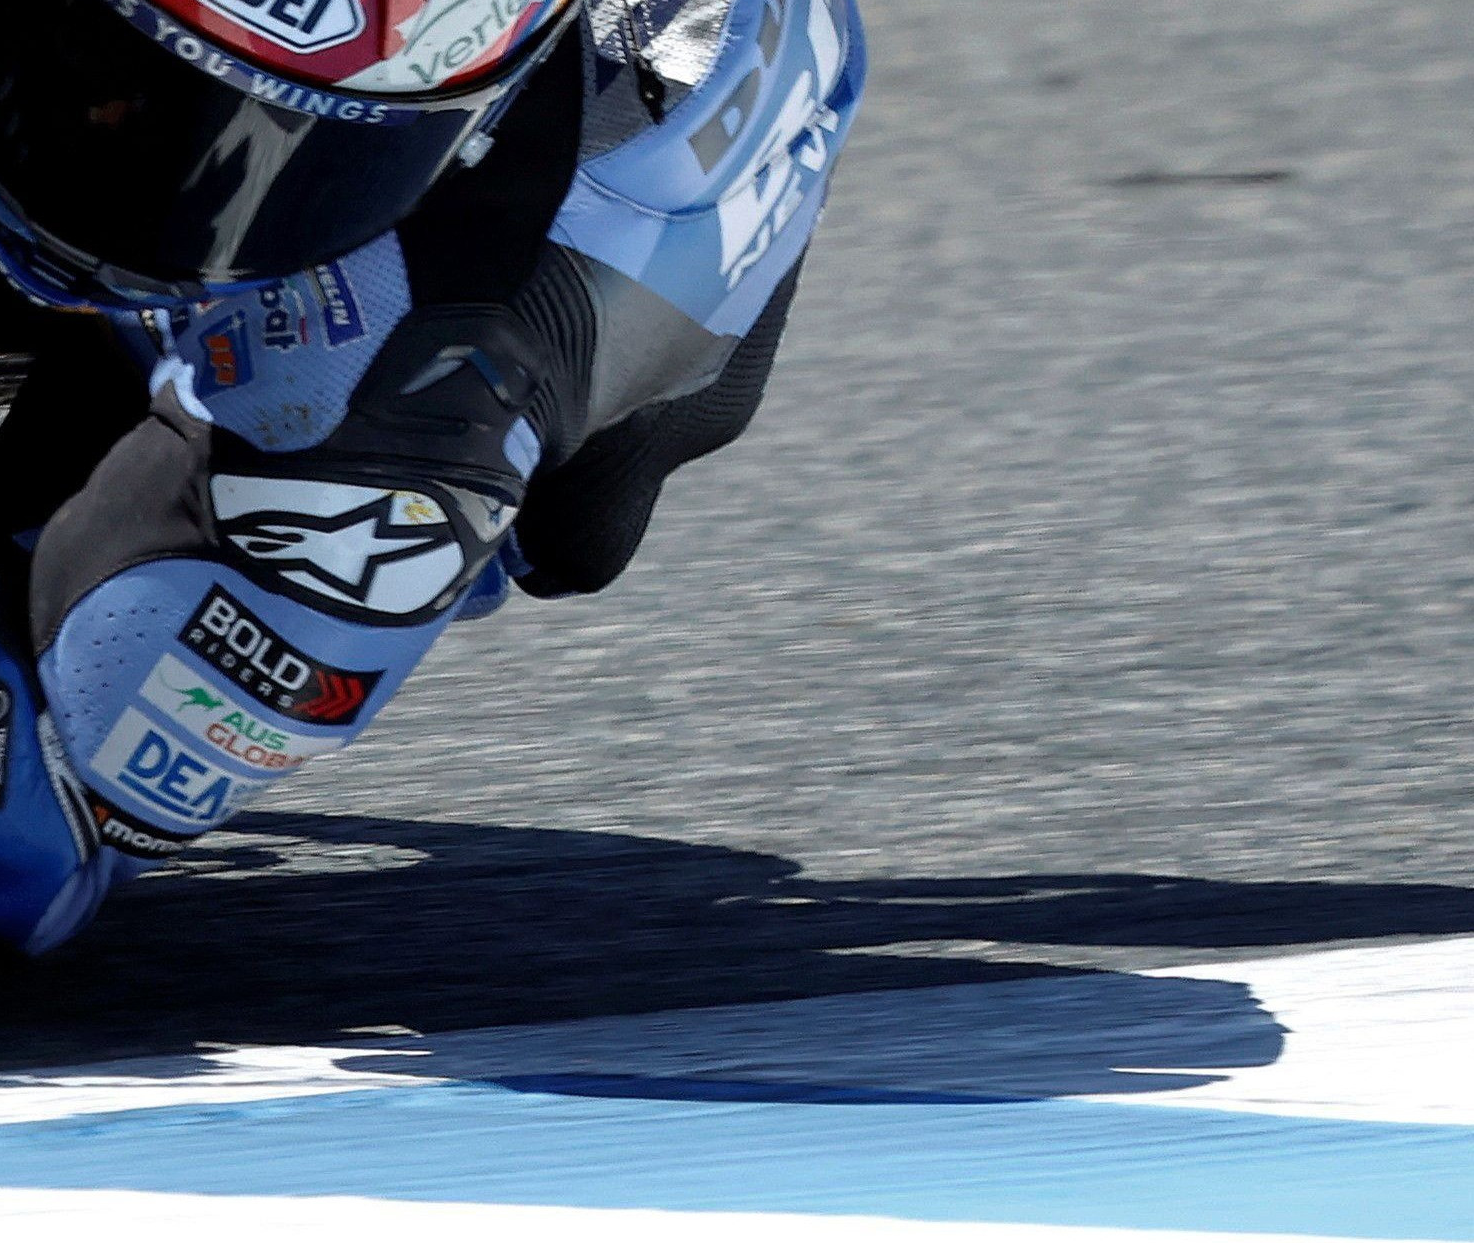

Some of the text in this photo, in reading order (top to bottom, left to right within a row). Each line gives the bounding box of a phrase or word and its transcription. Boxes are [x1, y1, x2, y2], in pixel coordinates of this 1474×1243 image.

[154, 15, 235, 78] YOU
[250, 72, 390, 124] WINGS
[188, 627, 295, 708] RIDERS
[201, 596, 311, 691] BOLD
[126, 728, 233, 821] DEA
[222, 711, 291, 751] AUS
